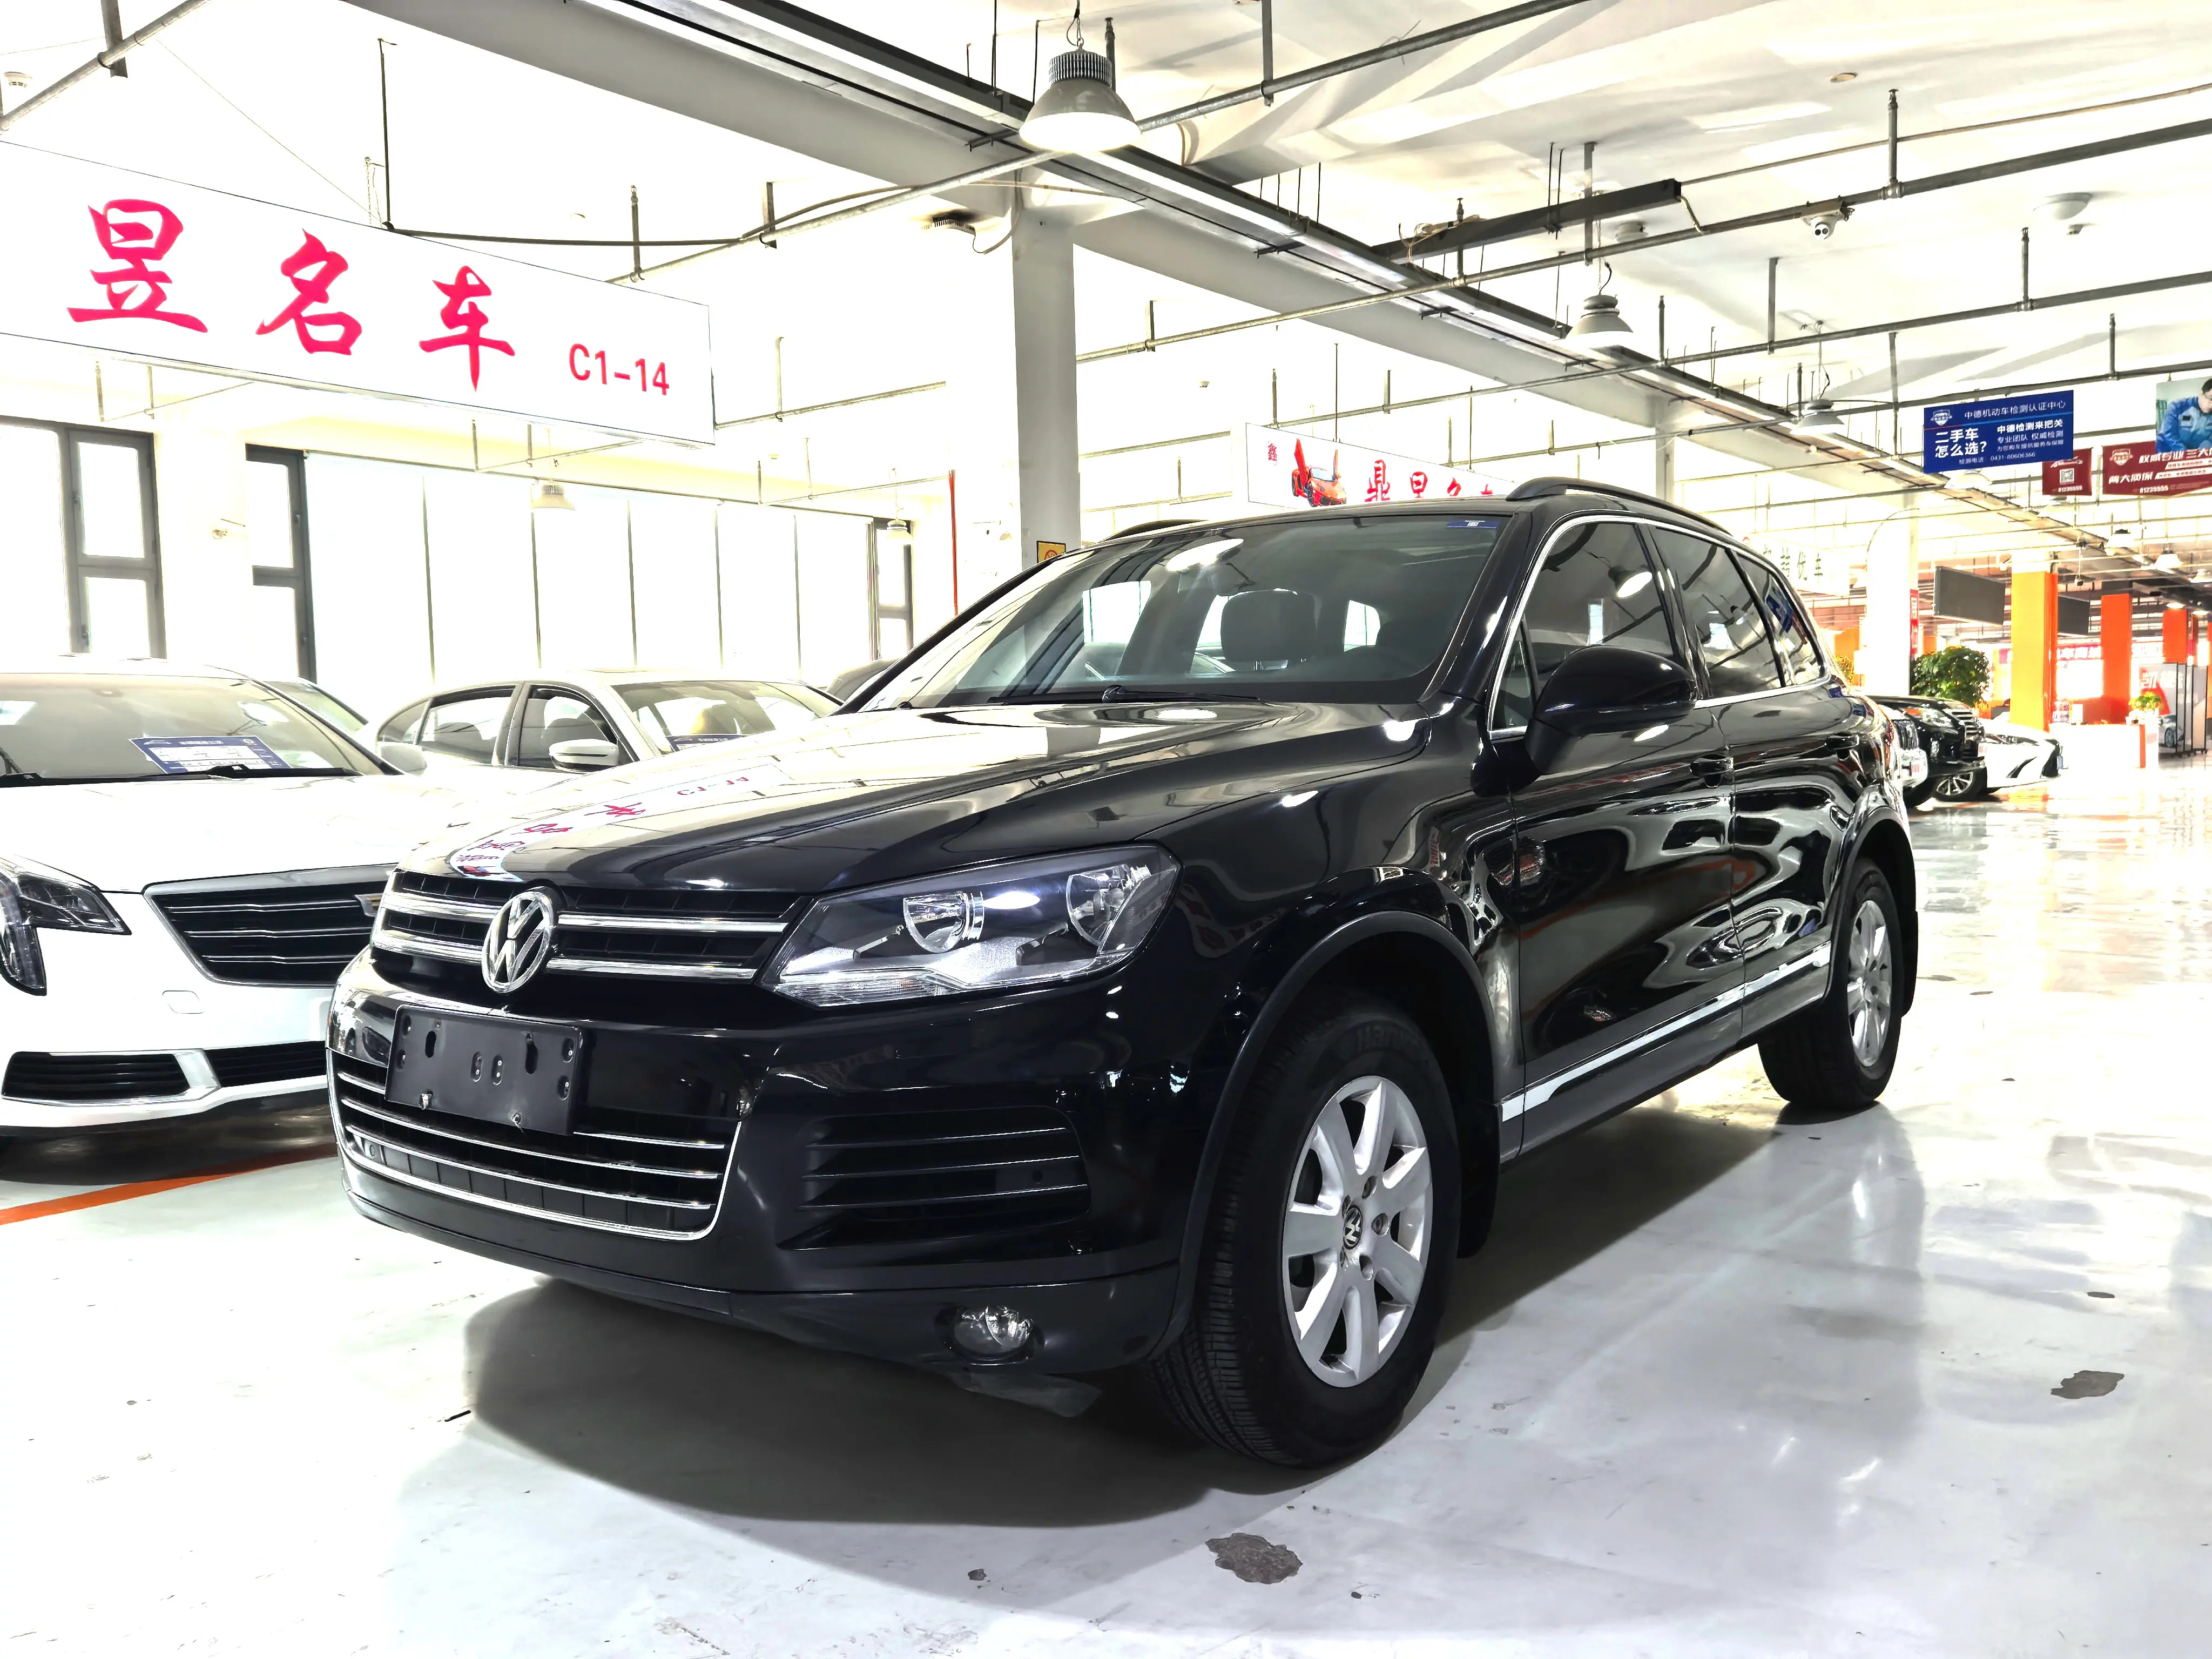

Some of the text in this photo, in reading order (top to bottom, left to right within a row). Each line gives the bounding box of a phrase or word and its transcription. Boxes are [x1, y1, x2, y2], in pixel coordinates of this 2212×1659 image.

[66, 199, 670, 396] 昱名车 C1-14
[1964, 401, 2066, 420] 中德机动车检测认证中心
[1935, 427, 1979, 443] 二手车
[1997, 419, 2063, 434] 中德检测来把关
[1997, 429, 2063, 444] 专业团队 权威检测
[1365, 459, 1493, 502] 鼎昱
